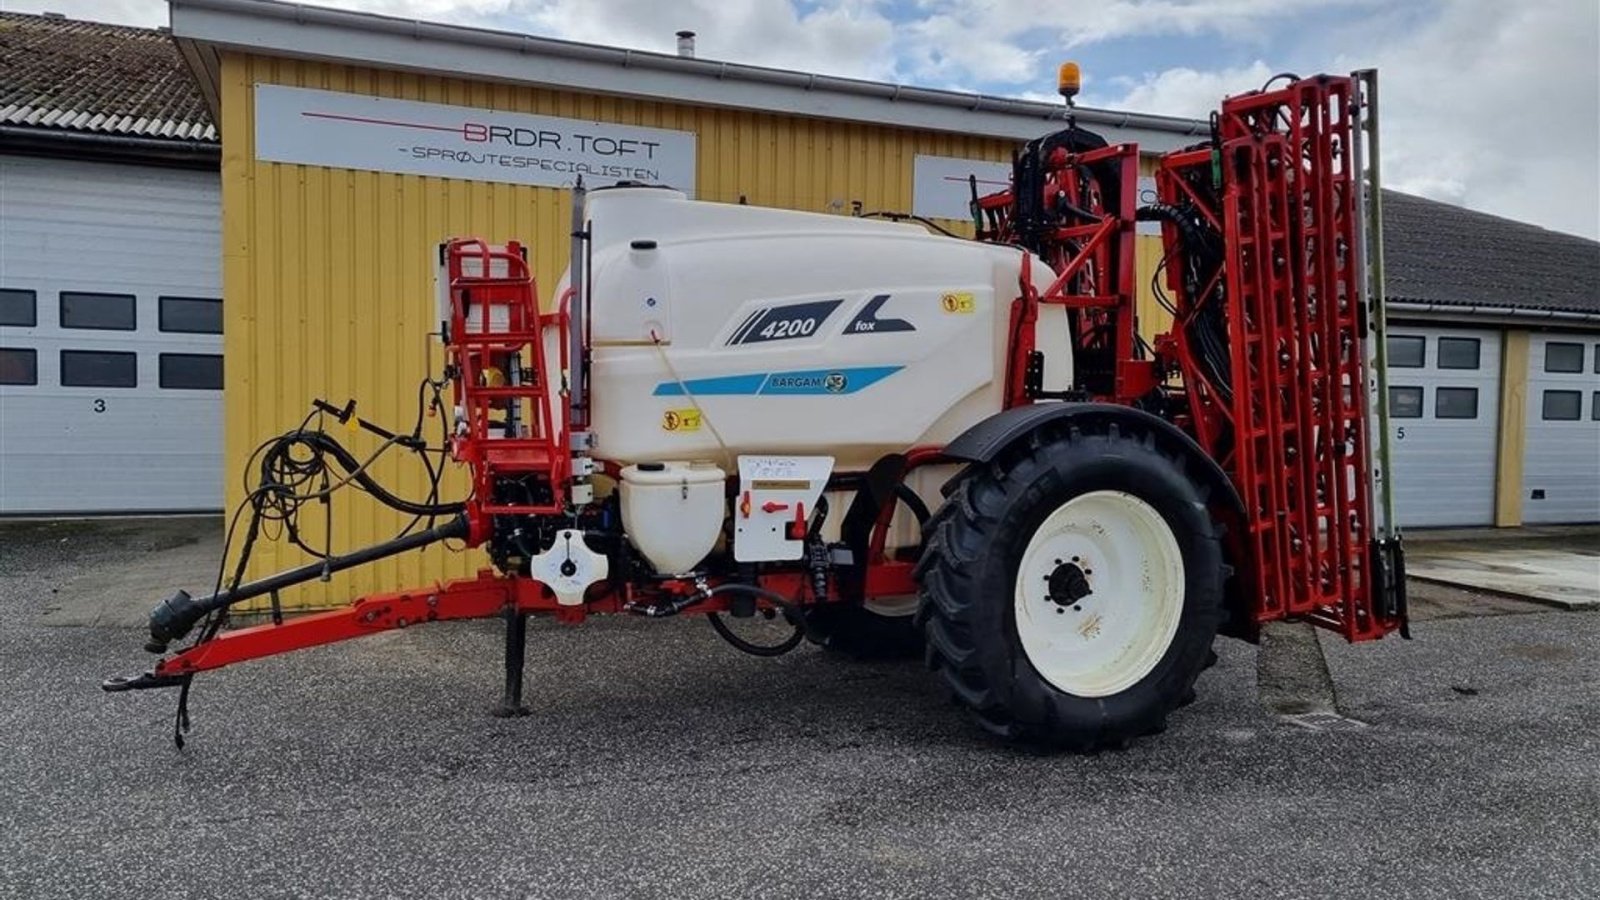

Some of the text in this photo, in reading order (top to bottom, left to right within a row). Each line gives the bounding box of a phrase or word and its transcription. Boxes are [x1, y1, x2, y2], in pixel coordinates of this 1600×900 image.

[760, 318, 816, 339] 4200
[855, 320, 876, 331] fox
[771, 378, 821, 388] BARGAM
[94, 399, 106, 413] 3
[1397, 427, 1405, 440] 5
